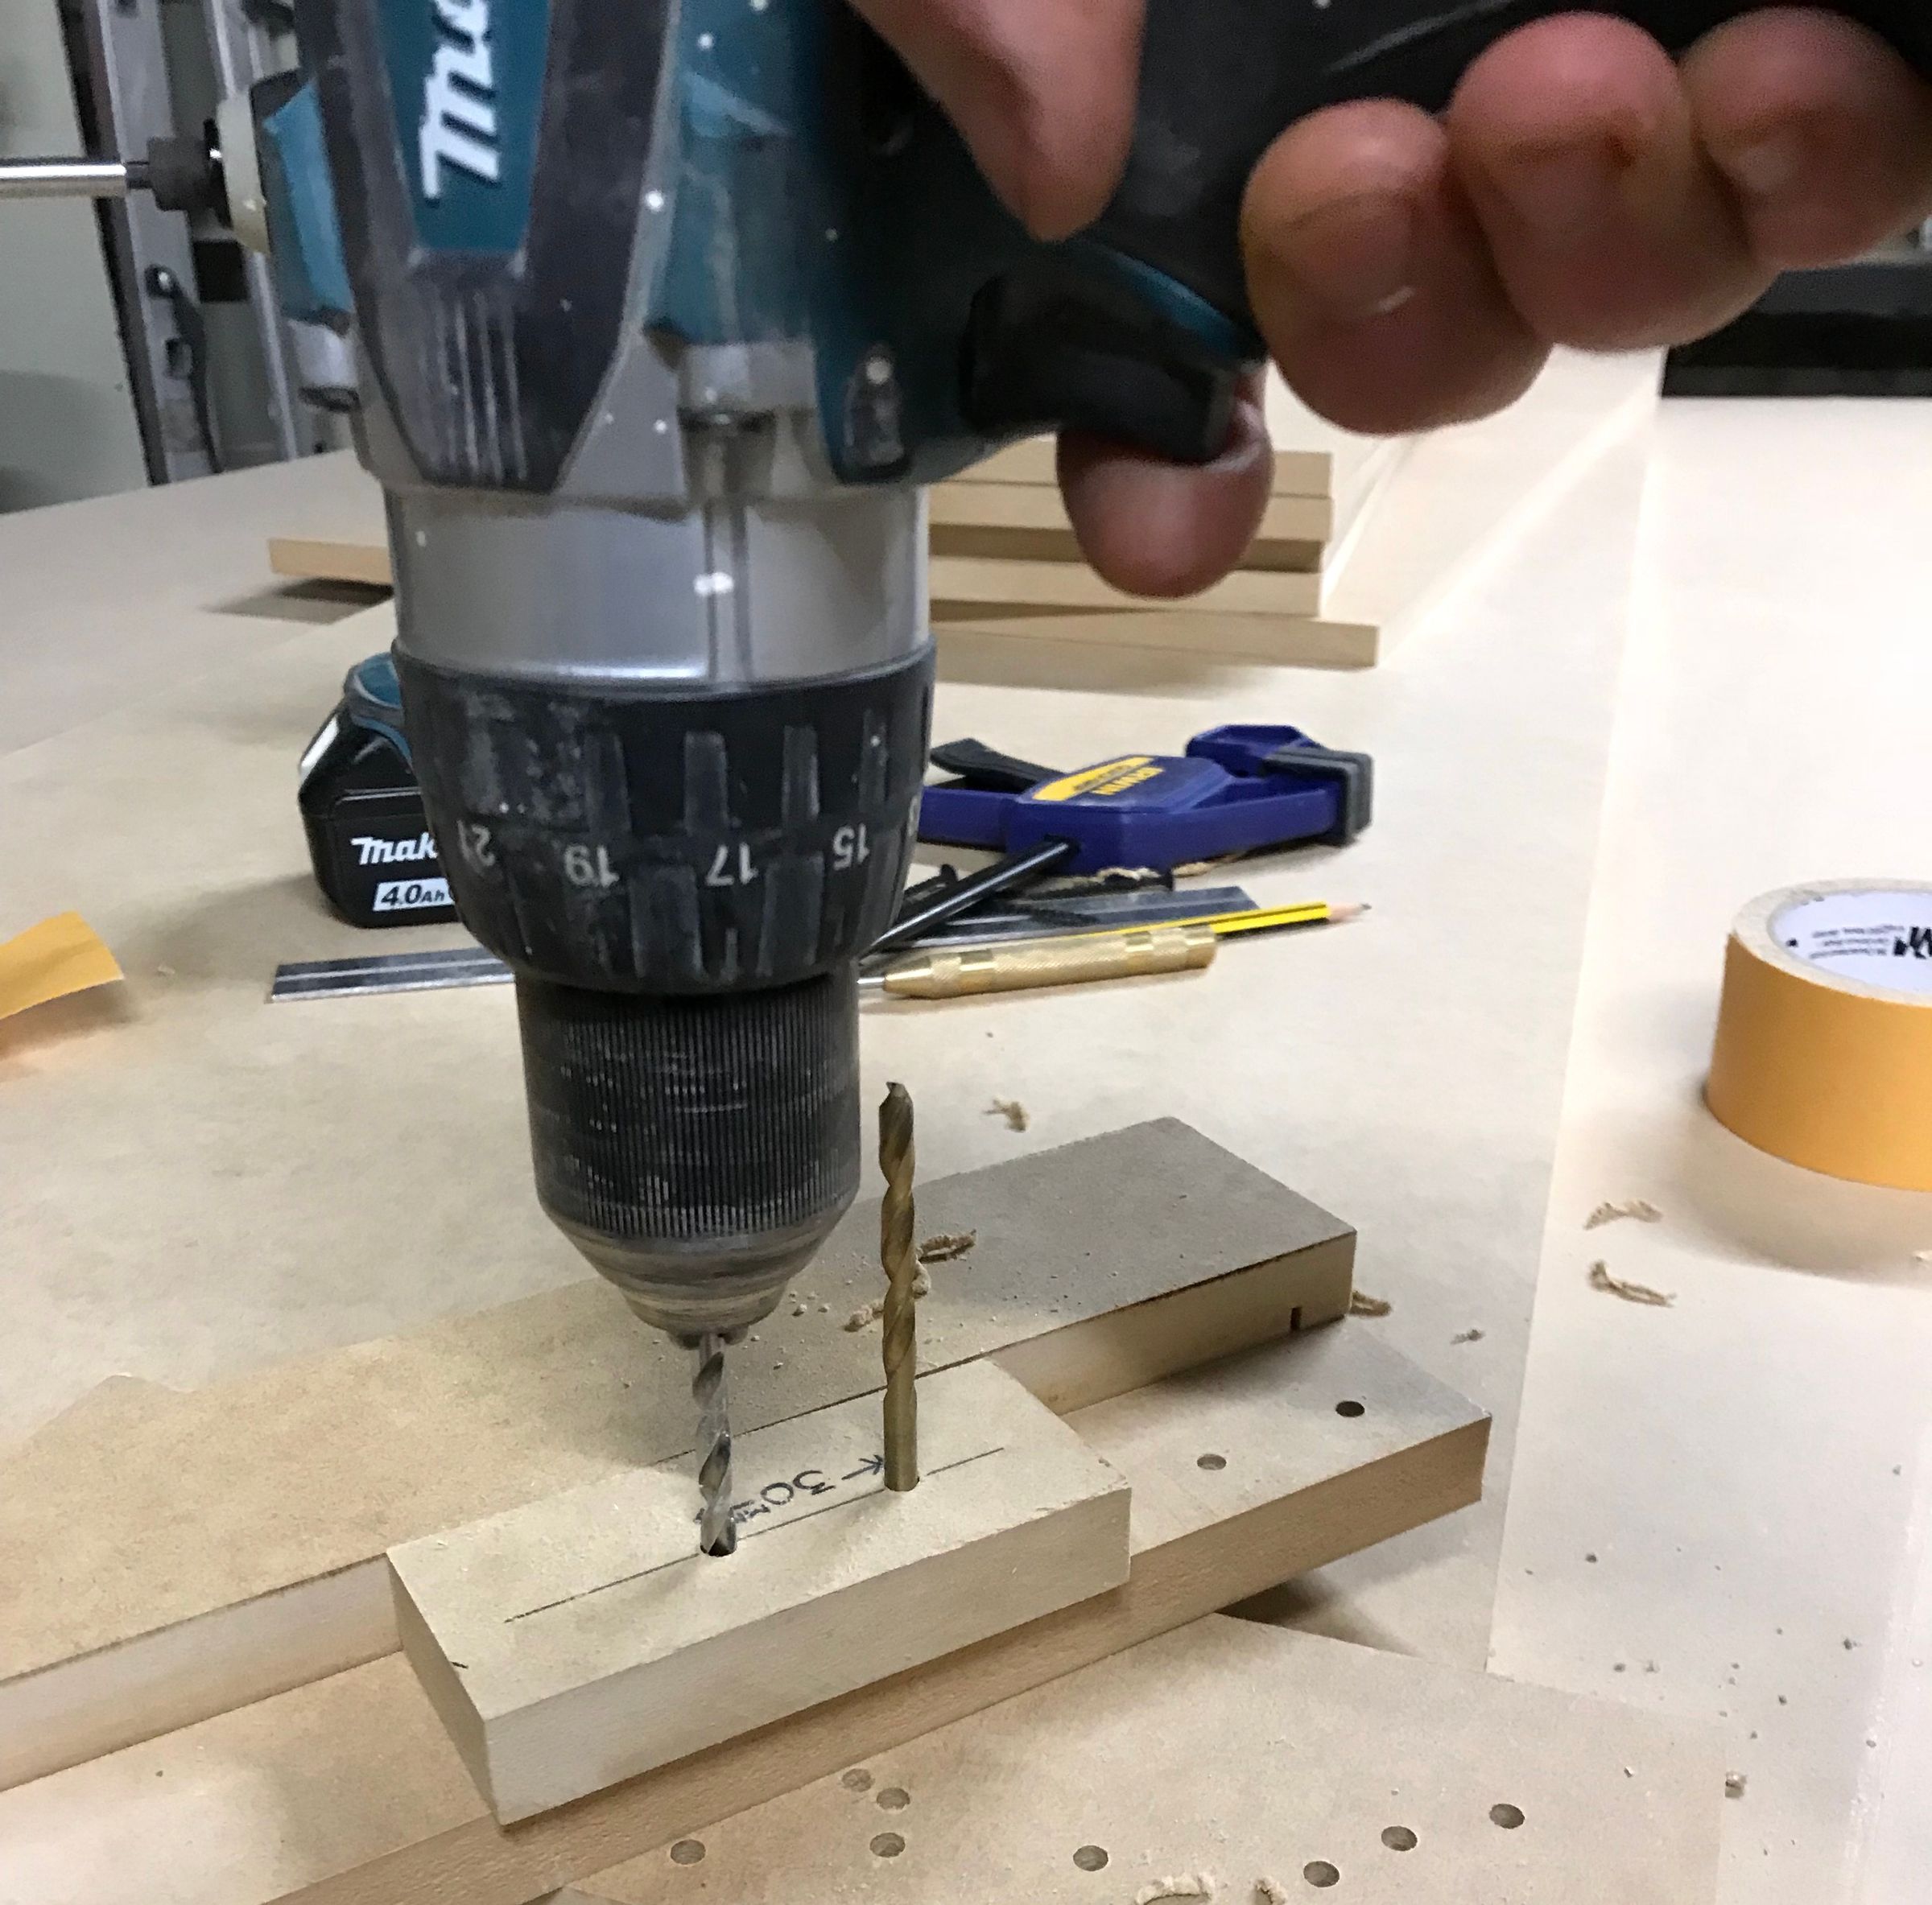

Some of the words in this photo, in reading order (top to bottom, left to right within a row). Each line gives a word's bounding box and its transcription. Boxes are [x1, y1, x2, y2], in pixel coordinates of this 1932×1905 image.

[565, 843, 620, 886] 19
[706, 842, 759, 885] 17
[832, 823, 870, 872] 15
